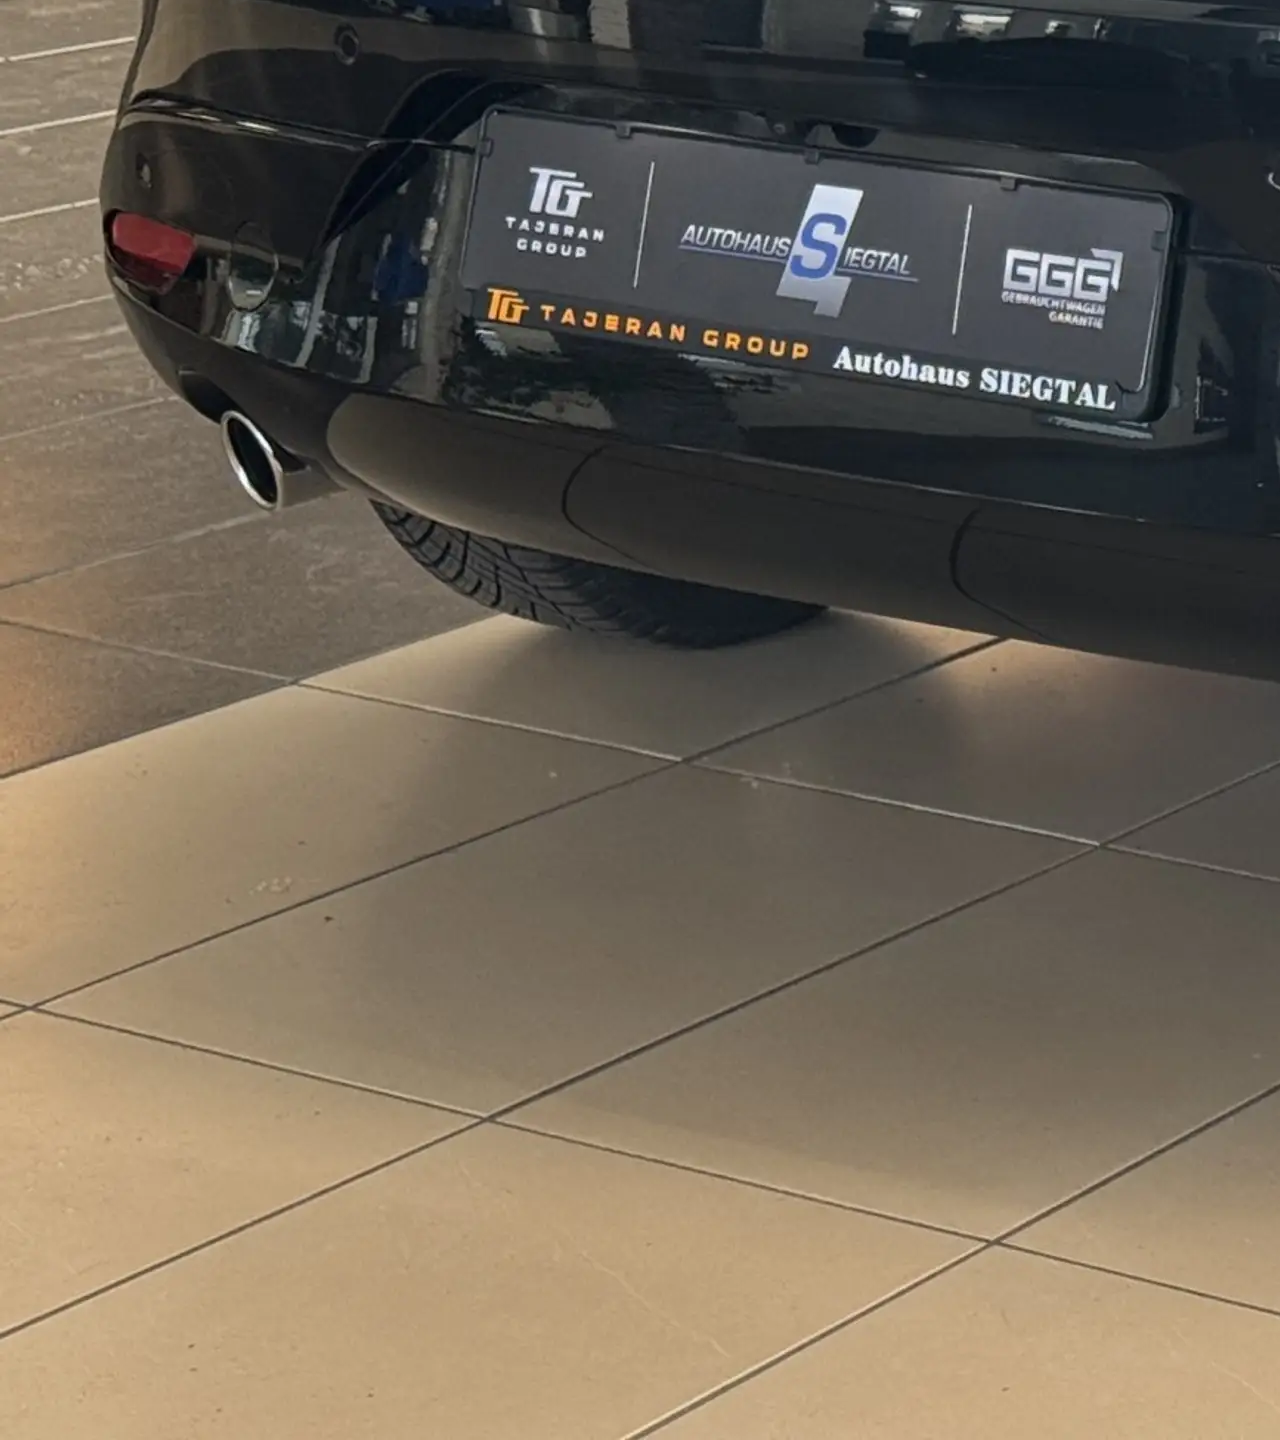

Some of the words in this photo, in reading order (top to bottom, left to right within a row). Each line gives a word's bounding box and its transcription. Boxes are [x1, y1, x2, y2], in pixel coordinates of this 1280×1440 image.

[529, 167, 593, 218] TG
[505, 216, 604, 242] TAJERAN
[681, 224, 792, 258] AUTOHAUS
[516, 238, 587, 258] GROUP
[1003, 248, 1113, 302] GGG
[1001, 291, 1106, 317] GEBRAUCHTWAGEN
[1048, 311, 1104, 329] GARANTIE
[487, 288, 530, 324] TG
[540, 304, 685, 342] TAJERAN
[702, 329, 809, 360] GROUP
[833, 345, 971, 389] Autohaus
[979, 366, 1117, 411] SIEGTAL
